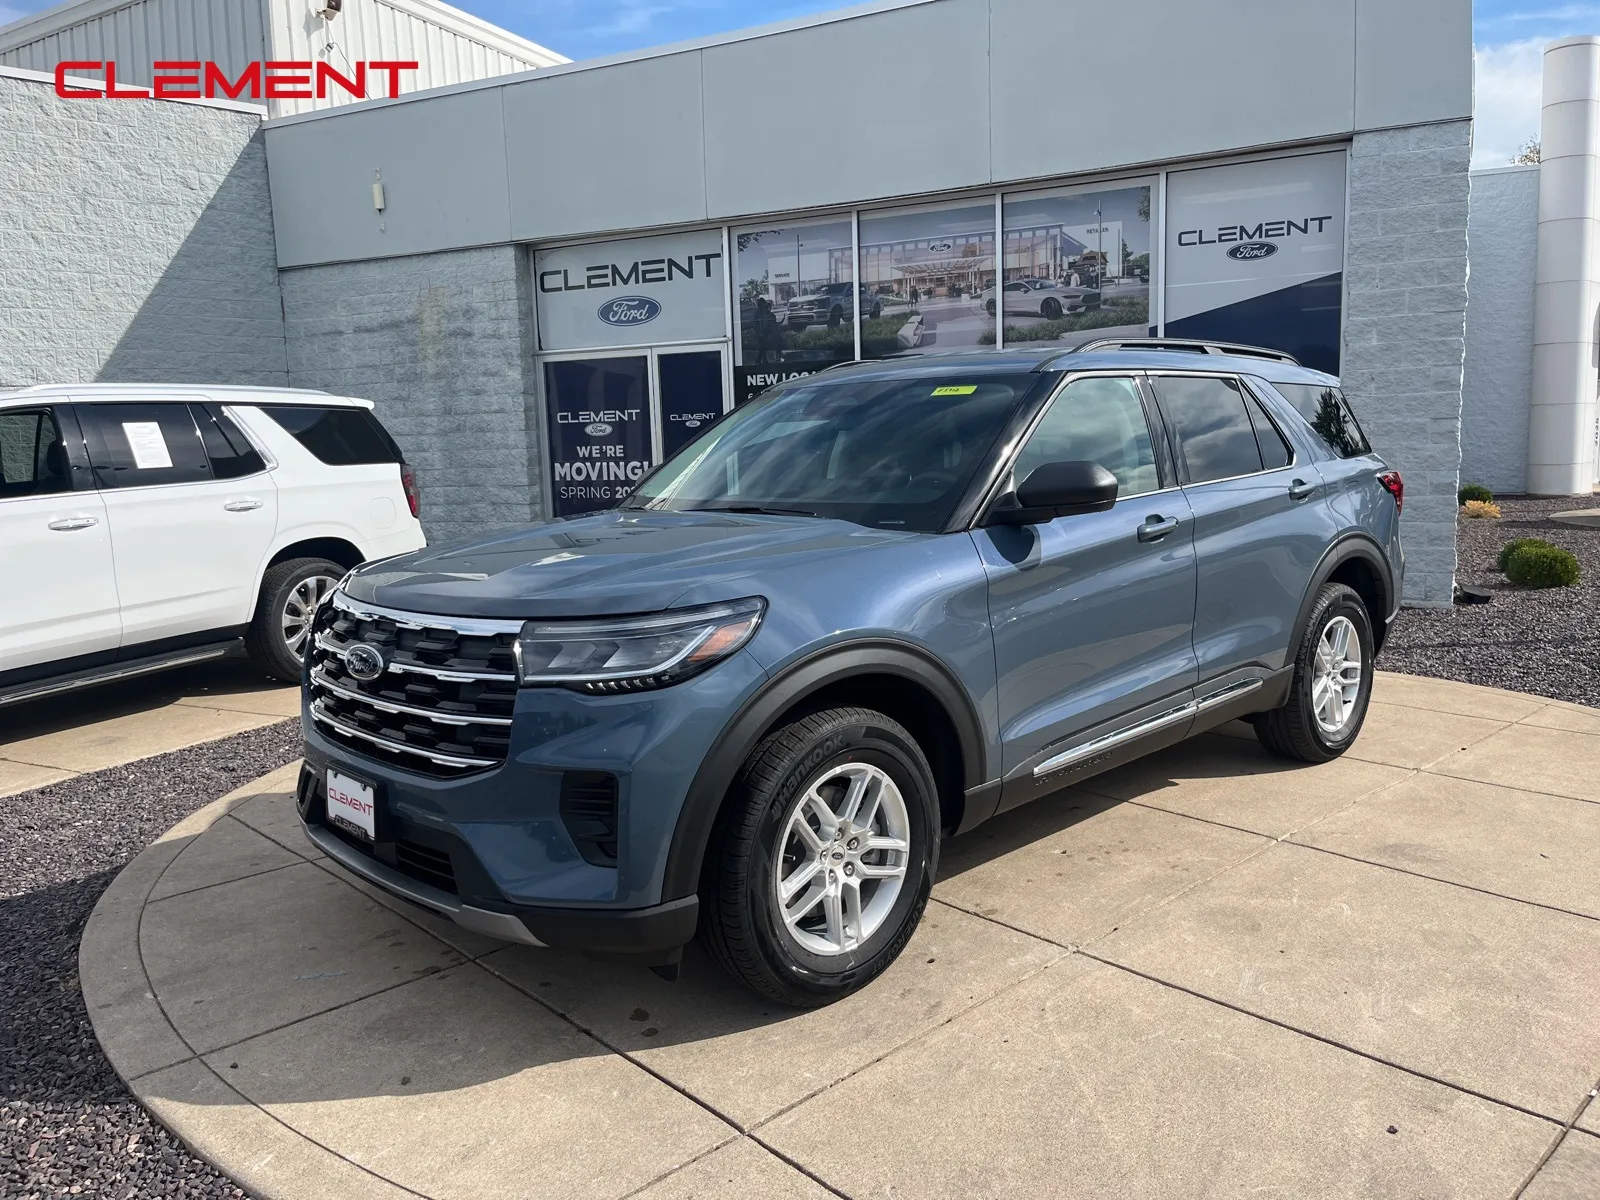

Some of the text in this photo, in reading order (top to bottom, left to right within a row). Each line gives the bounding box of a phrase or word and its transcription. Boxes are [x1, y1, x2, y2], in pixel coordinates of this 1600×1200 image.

[1177, 215, 1333, 247] CLEMENT
[1236, 244, 1268, 258] Ford
[539, 253, 722, 293] CLEMENT
[609, 300, 649, 321] Ford
[747, 373, 779, 386] NEW
[557, 409, 640, 424] CLEMENT
[669, 412, 716, 421] CLEMENT
[590, 425, 607, 434] Ford
[577, 445, 625, 458] WE'RE
[560, 486, 611, 499] SPRING
[329, 787, 373, 816] CLEMENT
[335, 816, 366, 838] CLEMENT
